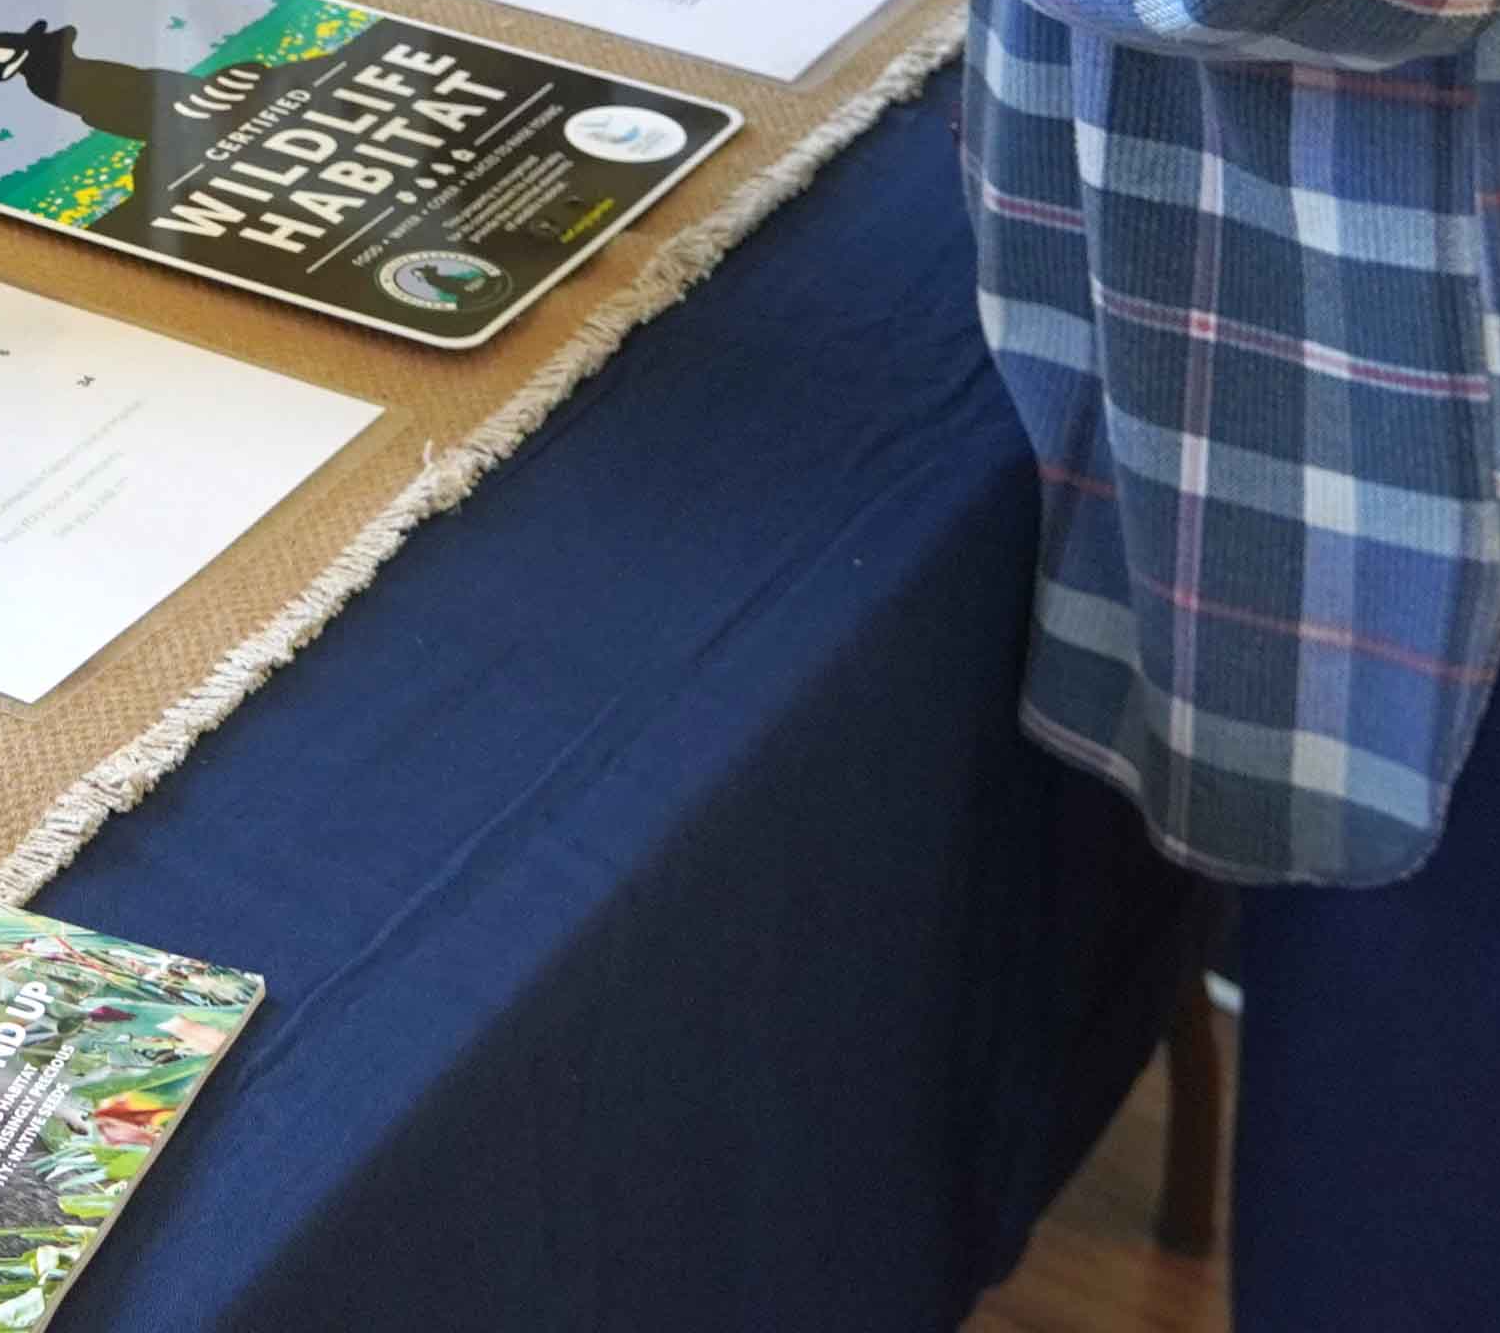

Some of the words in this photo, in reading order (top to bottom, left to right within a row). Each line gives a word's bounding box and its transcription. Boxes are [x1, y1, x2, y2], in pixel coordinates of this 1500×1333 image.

[151, 43, 456, 237] WILDLIFE
[204, 89, 311, 161] CERTIFIED
[239, 69, 506, 254] HABITAT
[5, 980, 62, 1023] UP
[28, 1044, 75, 1098] PRECIOUS
[7, 1115, 47, 1162] NATIVE
[38, 1082, 70, 1117] SEEDS
